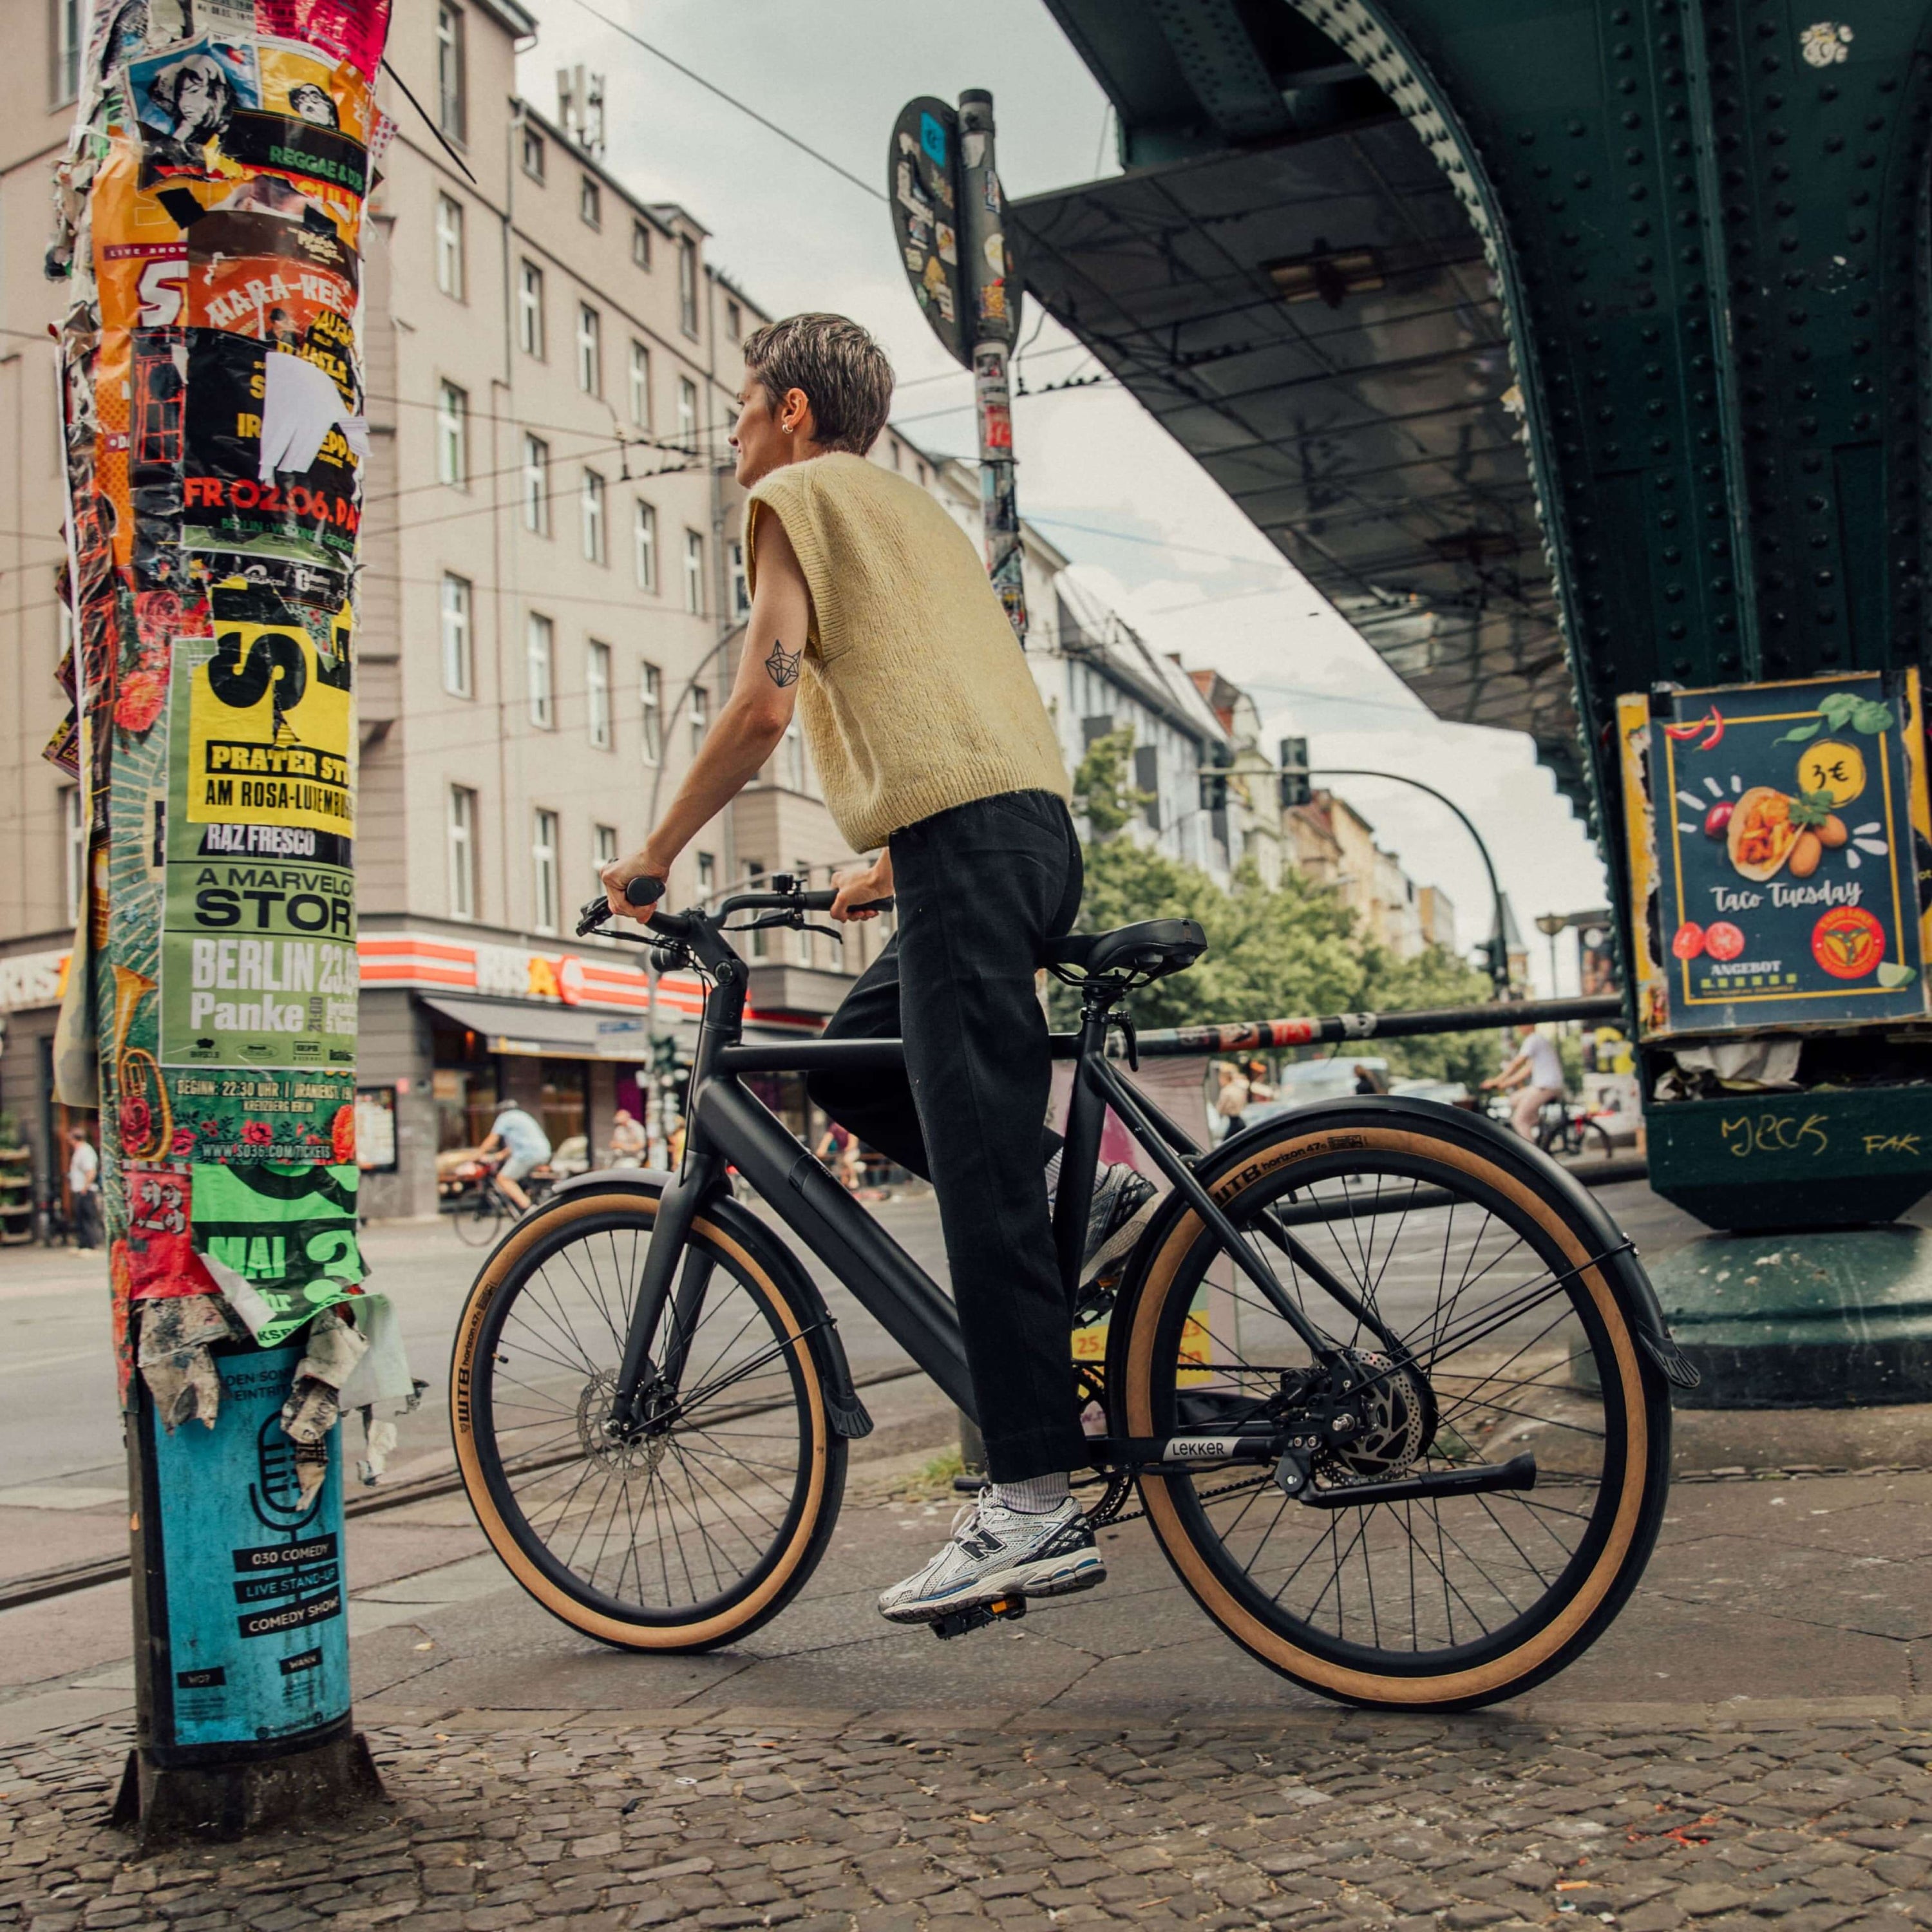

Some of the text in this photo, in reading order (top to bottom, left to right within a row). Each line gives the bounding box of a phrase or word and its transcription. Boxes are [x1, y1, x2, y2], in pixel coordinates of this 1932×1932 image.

[269, 145, 337, 178] REGGAE
[109, 247, 140, 257] LIVE
[184, 477, 225, 507] FR
[212, 746, 316, 777] PRATER
[205, 780, 232, 806] AM
[207, 824, 316, 856] RAZ FRESCO
[196, 868, 220, 886] A
[1710, 880, 1864, 913] Taco Tuesday
[193, 939, 315, 992] BERLIN
[1710, 960, 1782, 976] ANGEBOT
[190, 992, 304, 1032] Panke
[178, 1079, 218, 1095] BEGINN:
[222, 1081, 255, 1096] 22:30
[257, 1081, 279, 1097] UHR
[1261, 1147, 1306, 1171] horizon
[208, 1236, 286, 1279] MAI
[257, 1289, 292, 1312] hr
[462, 1328, 476, 1365] horizon
[457, 1367, 470, 1423] WTB
[252, 1544, 329, 1566] 030 COMEDY
[246, 1569, 336, 1598] LIVE STAND-UP
[249, 1611, 305, 1632] COMEDY
